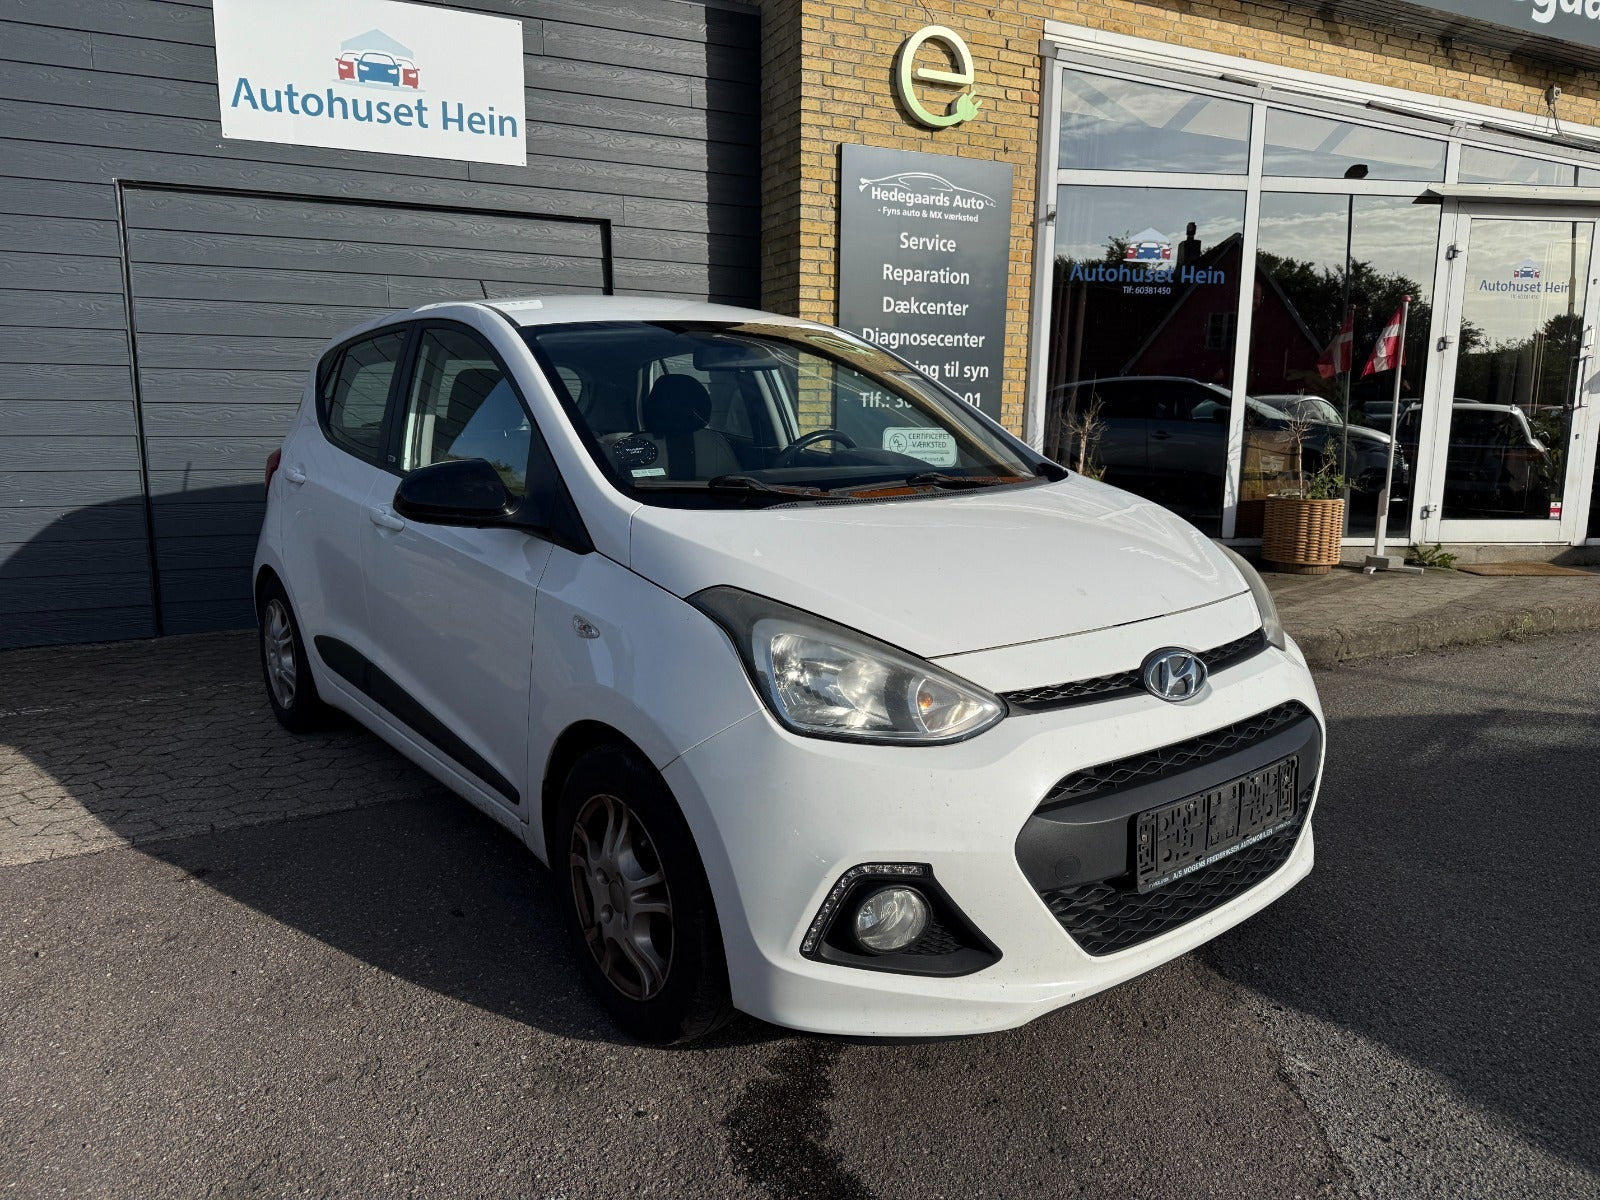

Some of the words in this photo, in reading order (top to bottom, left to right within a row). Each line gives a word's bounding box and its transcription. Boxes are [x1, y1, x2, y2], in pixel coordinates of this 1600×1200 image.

[231, 77, 429, 129] Autohuset
[441, 101, 518, 138] Hein
[871, 186, 950, 206] Hedegaards
[952, 195, 985, 210] Auto
[882, 206, 900, 217] Fyns
[902, 209, 920, 218] auto
[921, 209, 928, 218] &
[929, 210, 943, 219] MX
[944, 211, 979, 223] værksted
[899, 232, 957, 252] Service
[882, 263, 970, 286] Reparation
[1069, 264, 1174, 284] Autohuset
[1180, 265, 1226, 285] Hein
[1135, 286, 1171, 295] 60381450
[1479, 280, 1541, 293] Autohuset
[882, 296, 969, 316] Dækcenter
[862, 327, 986, 350] Diagnosecenter
[943, 361, 960, 378] til
[963, 365, 989, 382] syn
